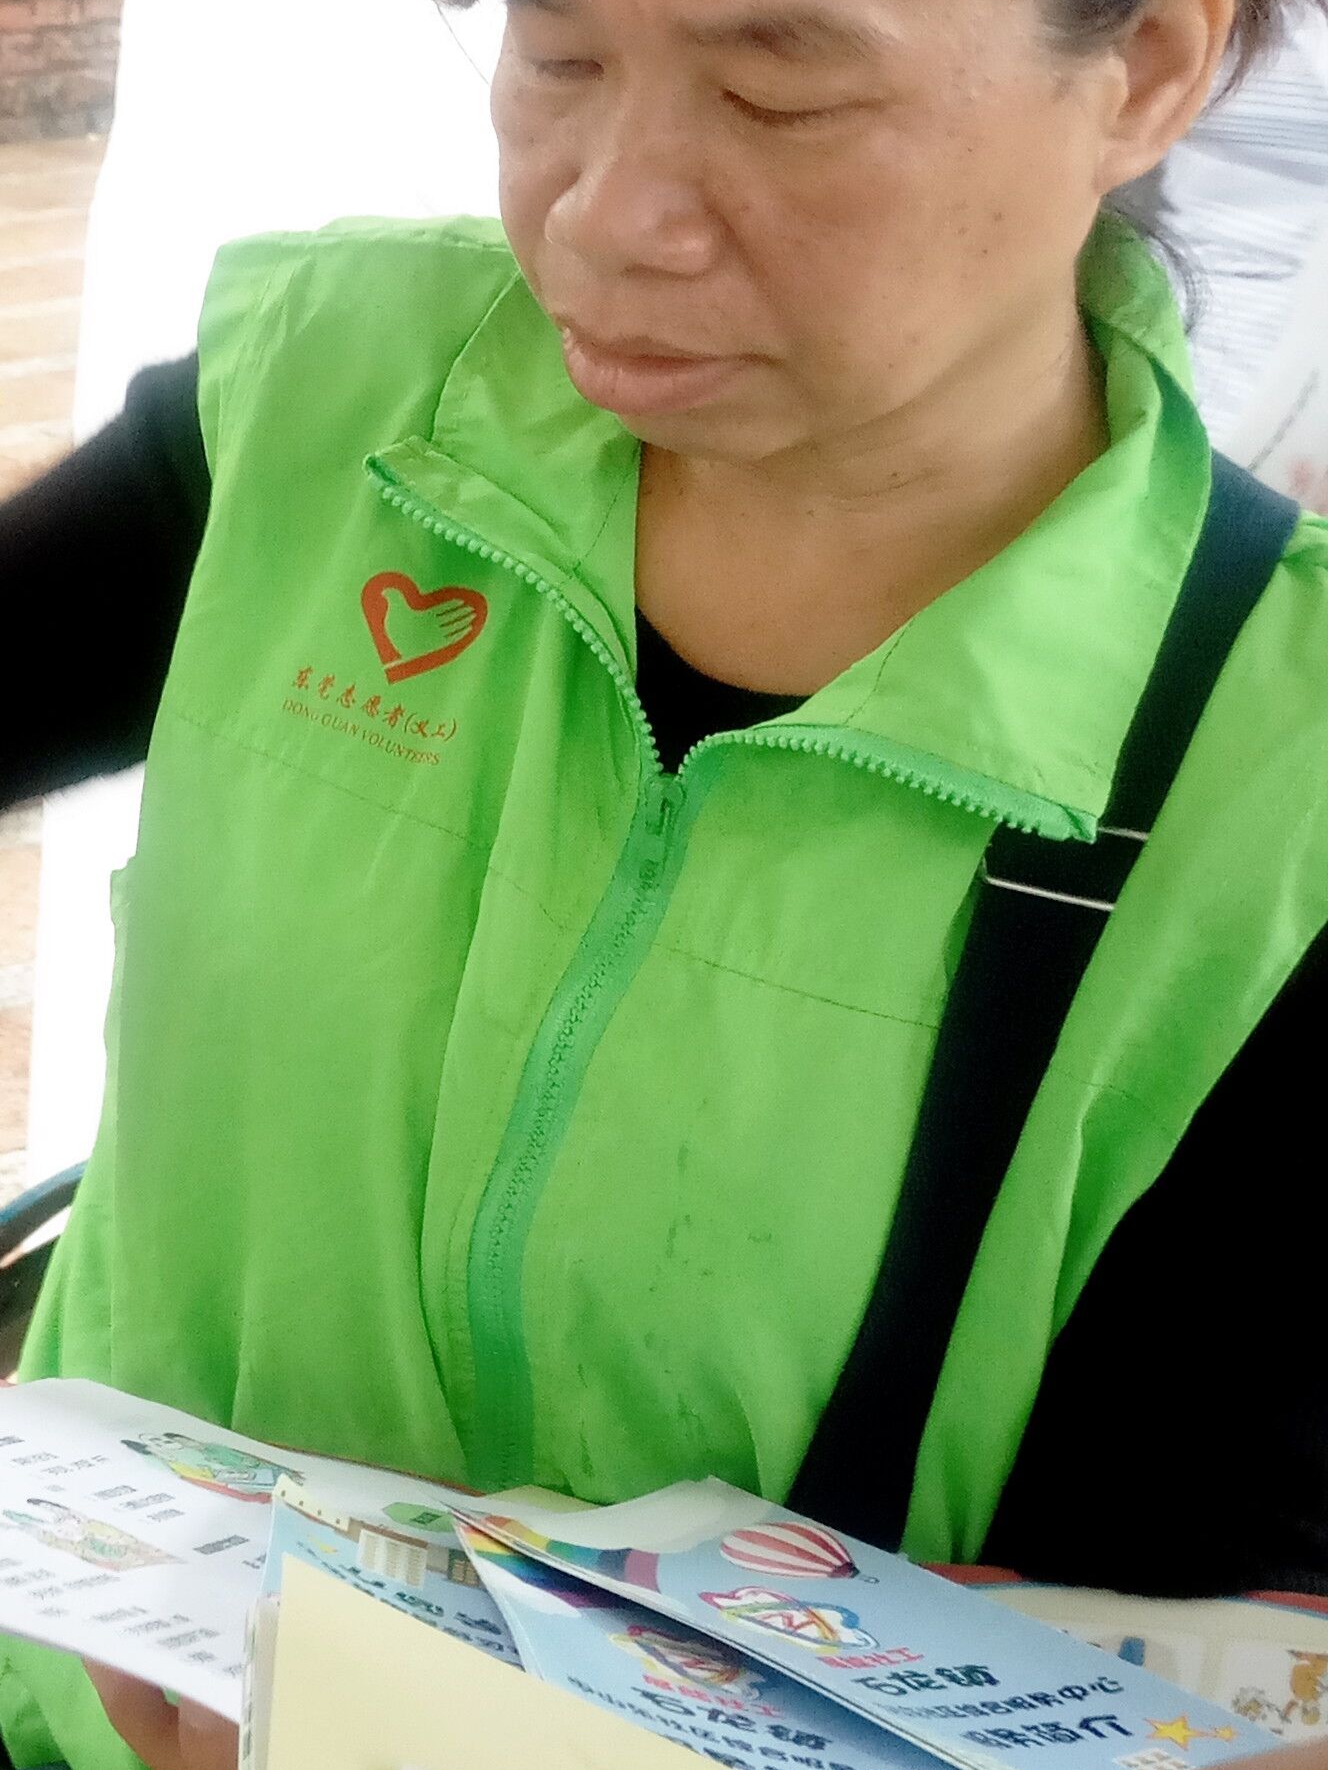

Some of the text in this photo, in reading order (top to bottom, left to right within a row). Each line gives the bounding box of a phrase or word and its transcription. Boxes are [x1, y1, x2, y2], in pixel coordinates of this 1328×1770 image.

[851, 1663, 1001, 1699] 石龙镇
[639, 1685, 835, 1753] 石龙镇
